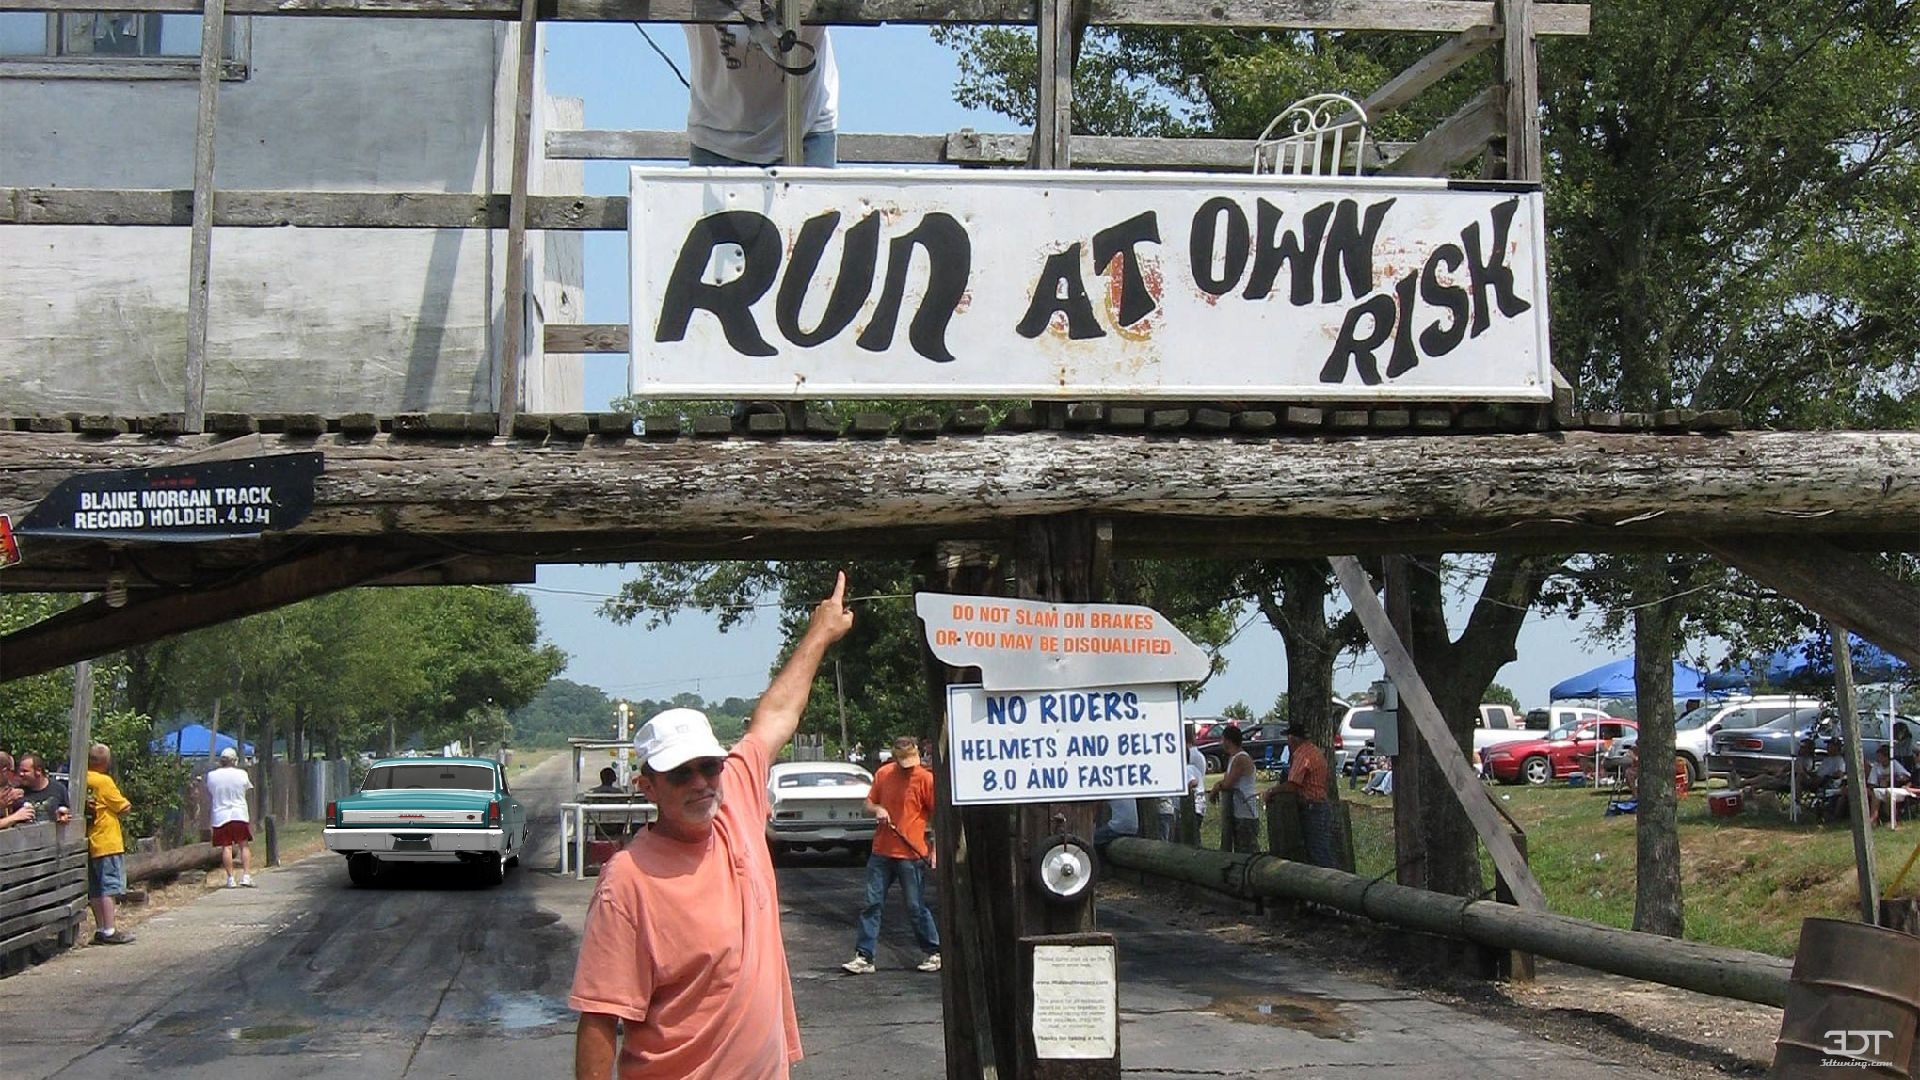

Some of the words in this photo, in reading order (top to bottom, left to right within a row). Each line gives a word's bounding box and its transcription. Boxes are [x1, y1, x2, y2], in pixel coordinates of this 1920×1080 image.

[1016, 211, 1161, 340] AT
[1190, 197, 1396, 302] OWN
[1320, 199, 1530, 385] RISK
[81, 491, 137, 509] BLAINE
[142, 489, 211, 508] MORGAN
[215, 487, 272, 505] TRACK
[75, 510, 144, 529] RECORD
[953, 604, 974, 621] DO
[979, 607, 1010, 623] NOT
[1016, 610, 1058, 628] SLAM
[1064, 613, 1085, 629] ON
[1090, 612, 1153, 630] BRAKES
[965, 631, 996, 648] YOU
[1000, 633, 1033, 651] MAY
[1040, 636, 1058, 652] BE
[1064, 637, 1177, 655] DISQUALIFIED.
[987, 695, 1027, 725] NO
[1040, 691, 1147, 724] RIDERS.
[961, 737, 1058, 761] HELMETS
[1067, 734, 1109, 757] AND
[1118, 732, 1177, 755] BELTS
[982, 768, 1017, 791] 8.0
[1027, 768, 1068, 790] AND
[1078, 763, 1159, 787] FASTER.
